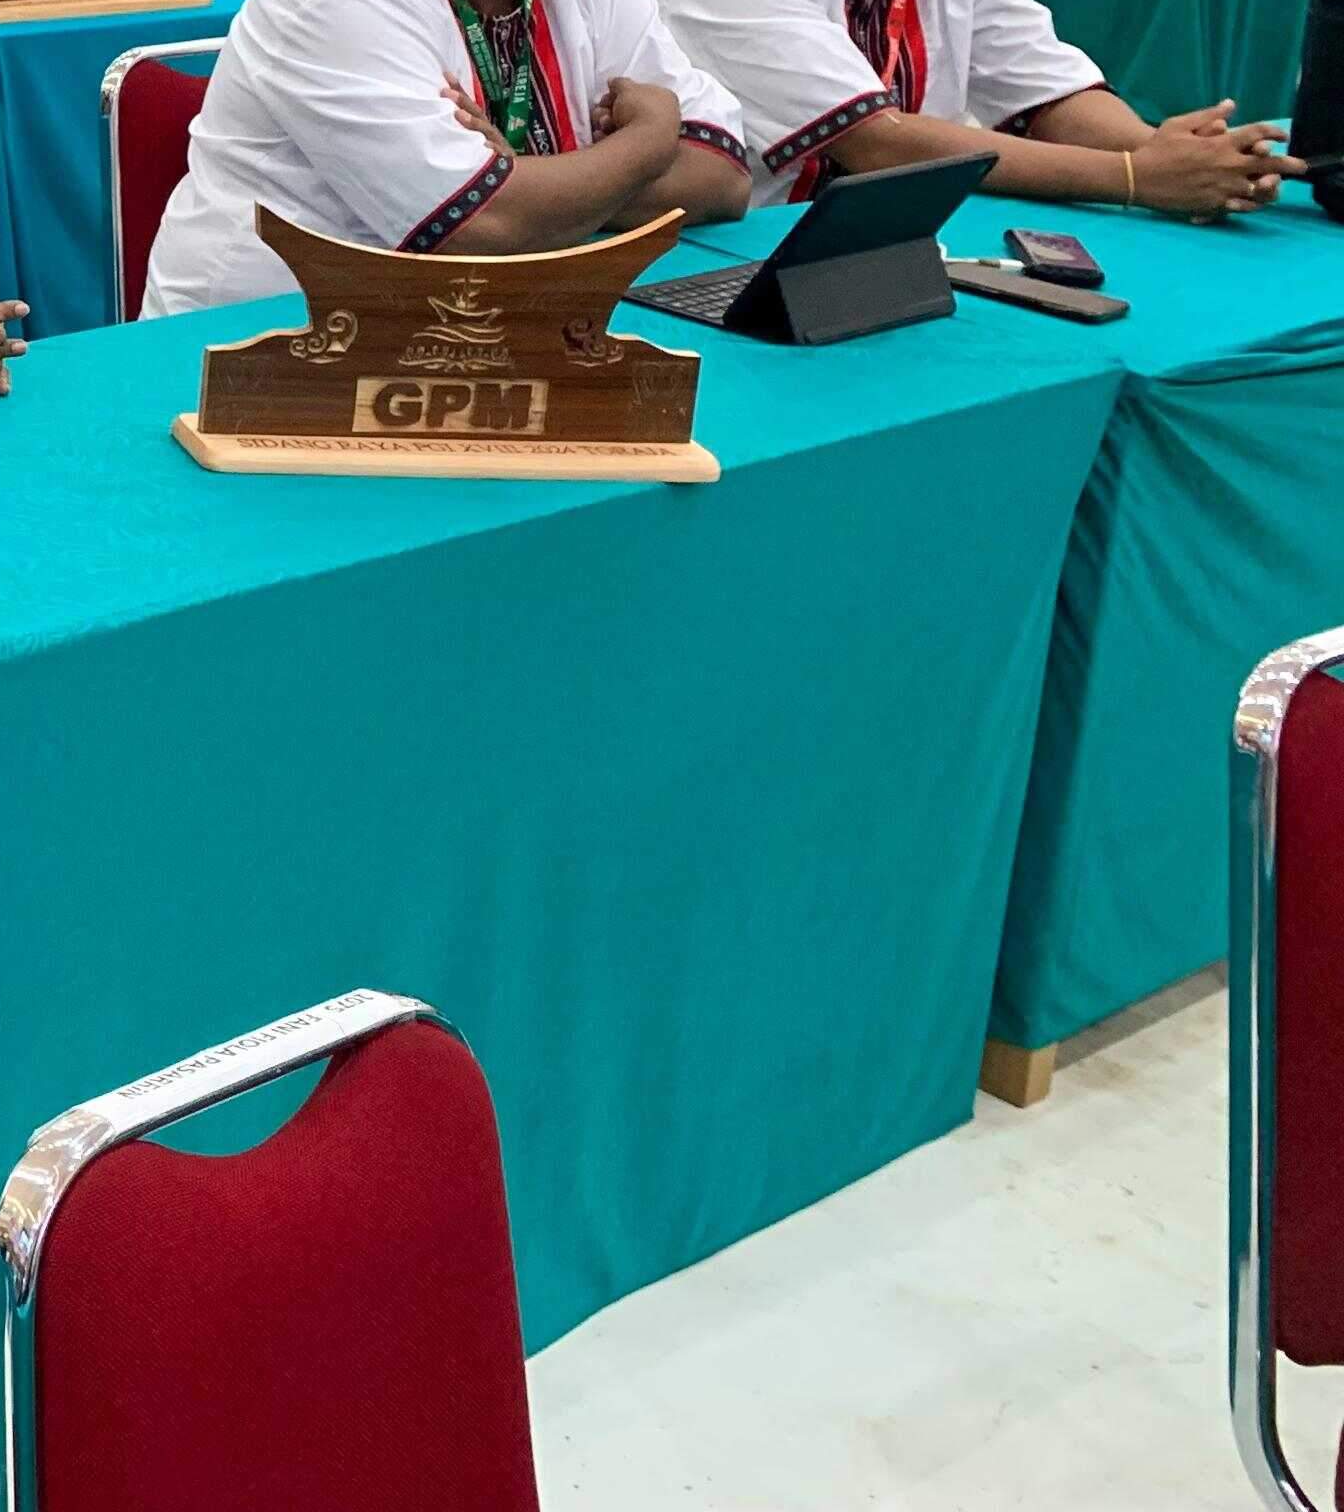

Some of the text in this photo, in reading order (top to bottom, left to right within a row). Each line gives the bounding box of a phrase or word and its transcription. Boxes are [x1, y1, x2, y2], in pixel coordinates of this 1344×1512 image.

[512, 64, 529, 104] GEREJA
[372, 381, 534, 431] GPM
[237, 437, 332, 451] SIDANG
